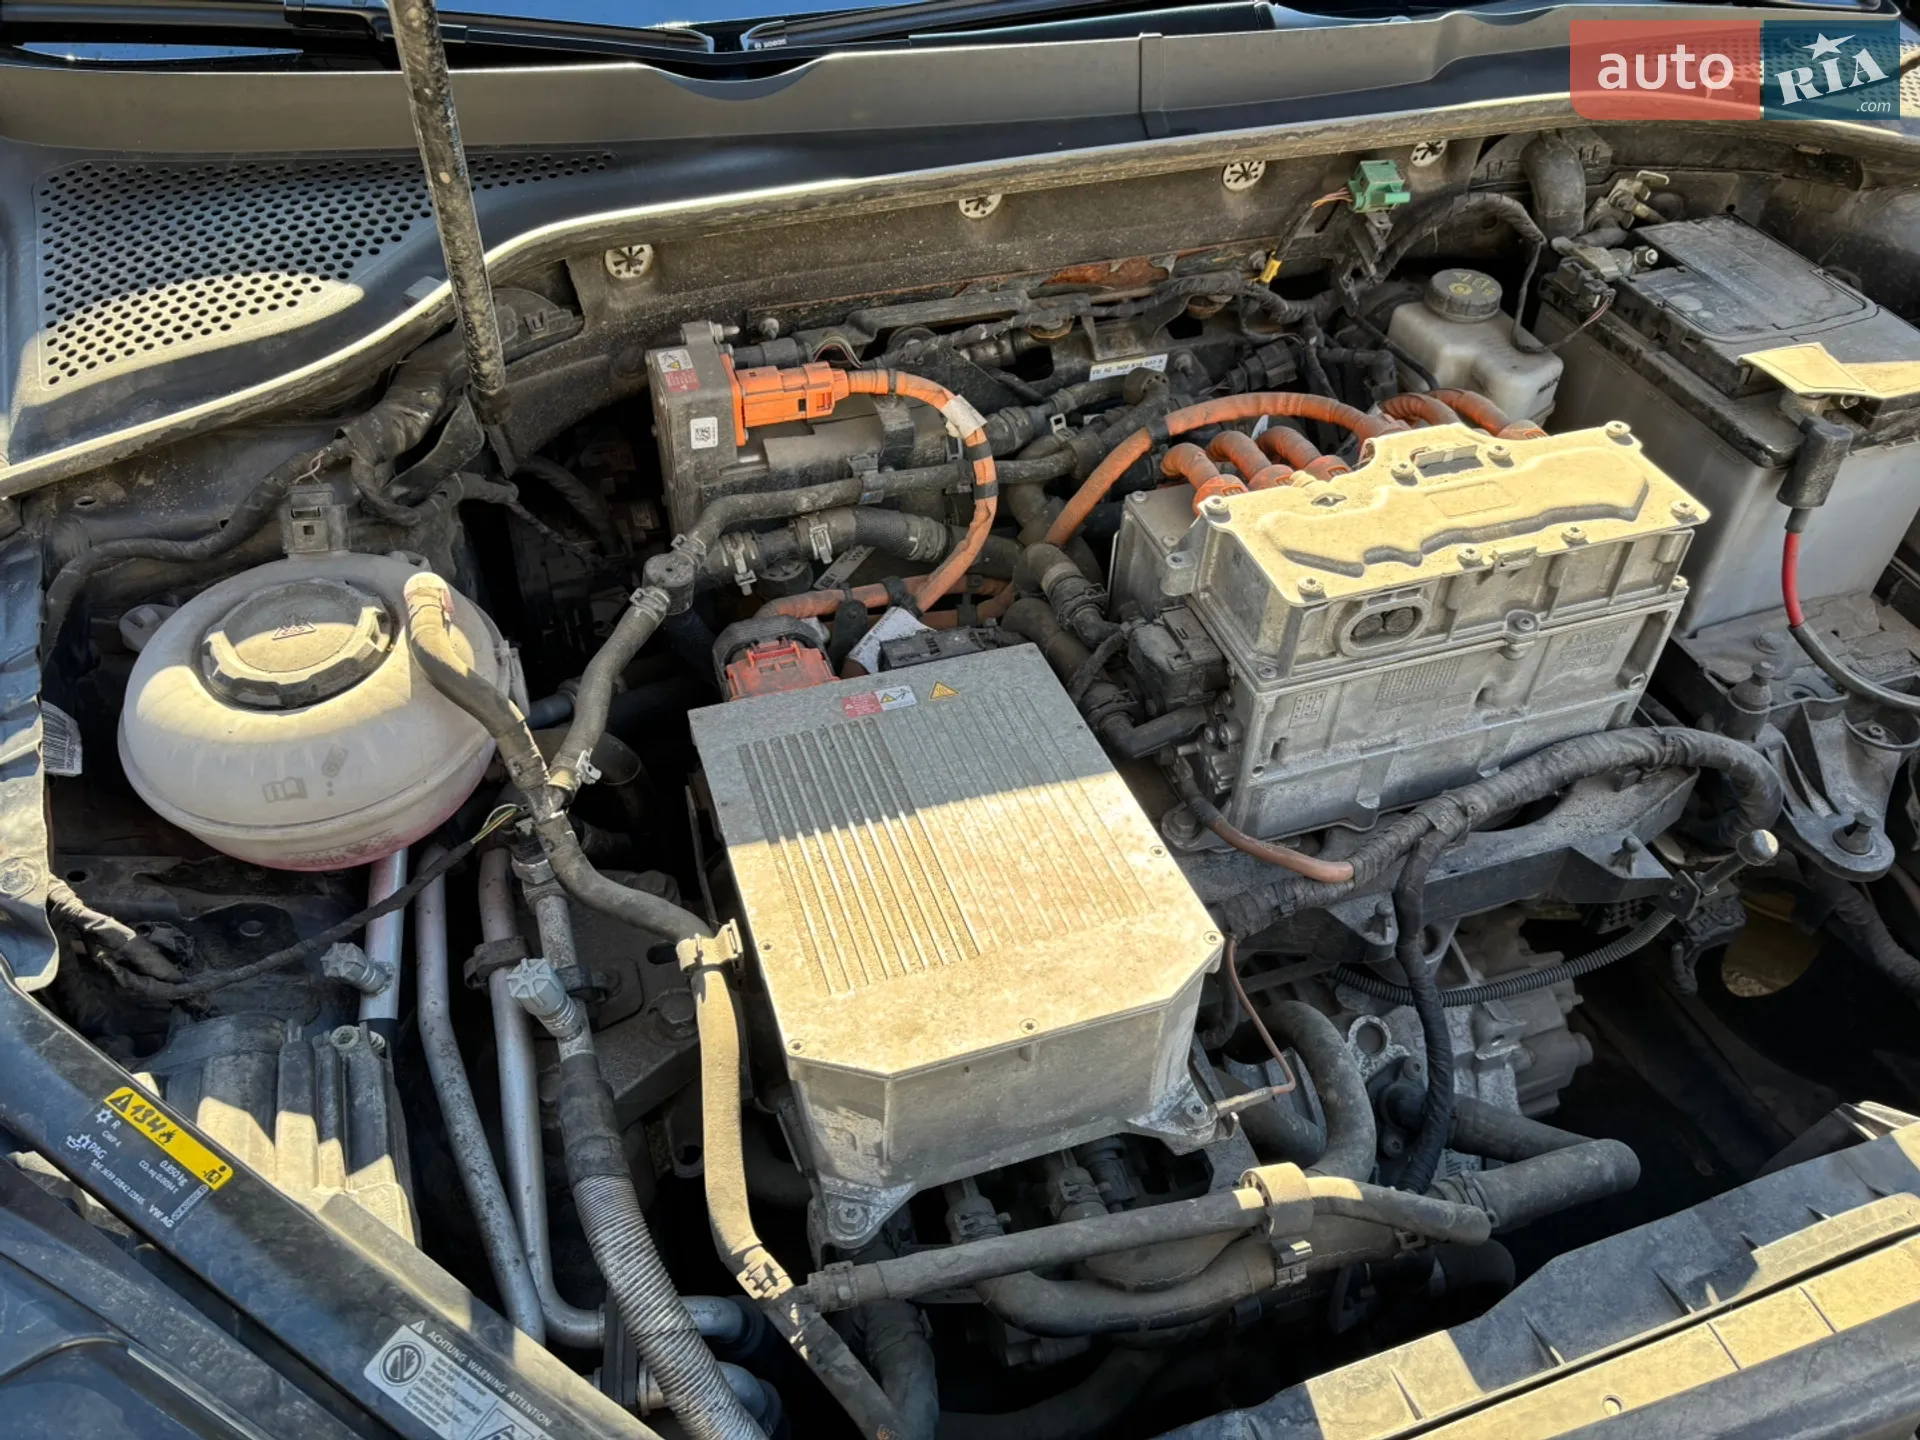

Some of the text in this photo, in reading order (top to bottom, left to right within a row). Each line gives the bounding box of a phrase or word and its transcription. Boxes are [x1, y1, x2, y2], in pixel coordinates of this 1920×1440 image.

[87, 1140, 108, 1160] PAG
[159, 1159, 181, 1180] 0.850
[148, 1204, 175, 1229] VW AG
[426, 1330, 468, 1362] ACHTUNG
[466, 1359, 508, 1394] WARNING
[505, 1389, 553, 1428] ATTENTION
